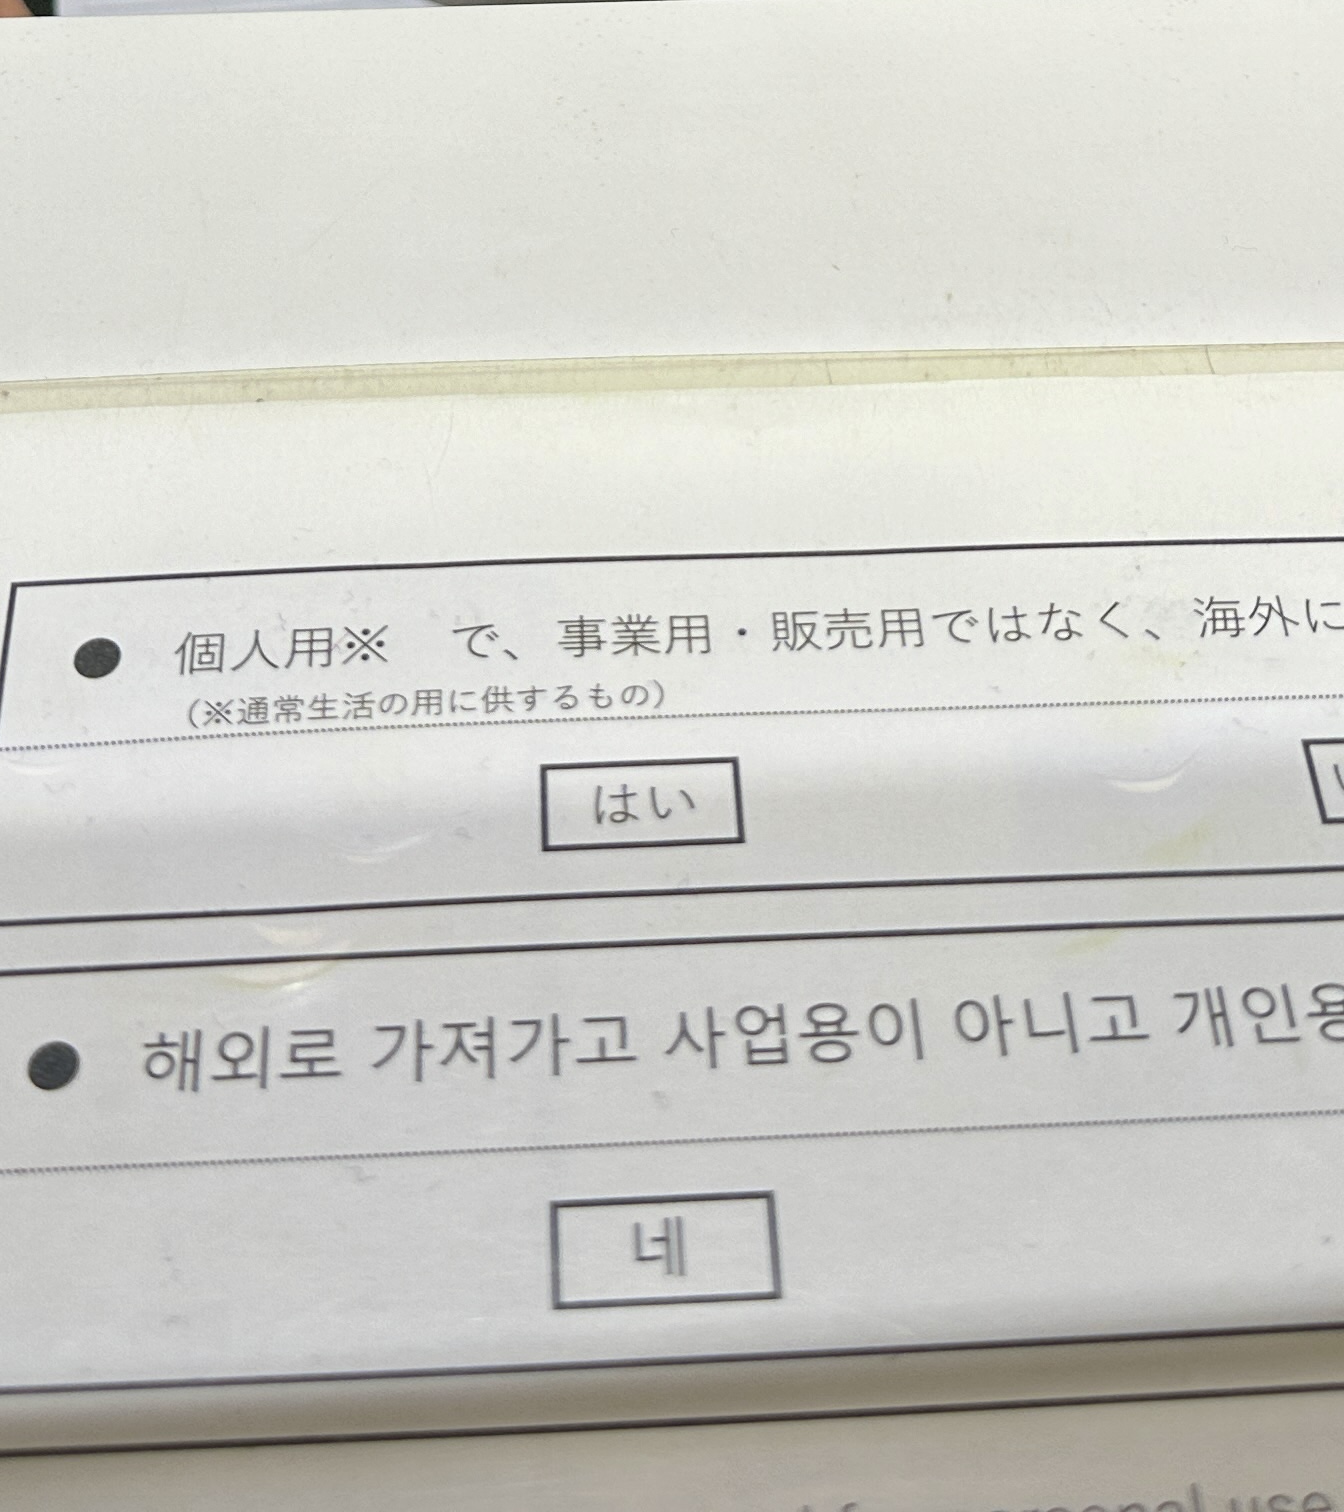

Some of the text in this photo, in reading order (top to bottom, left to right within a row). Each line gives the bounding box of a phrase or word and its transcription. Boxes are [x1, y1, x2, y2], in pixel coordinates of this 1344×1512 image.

[592, 784, 697, 826] はい
[143, 1025, 342, 1094] 해외로
[371, 1013, 638, 1083] 가져가고
[664, 997, 924, 1070] 사업용이
[954, 990, 1150, 1057] 아니고
[633, 1215, 687, 1277] 네
